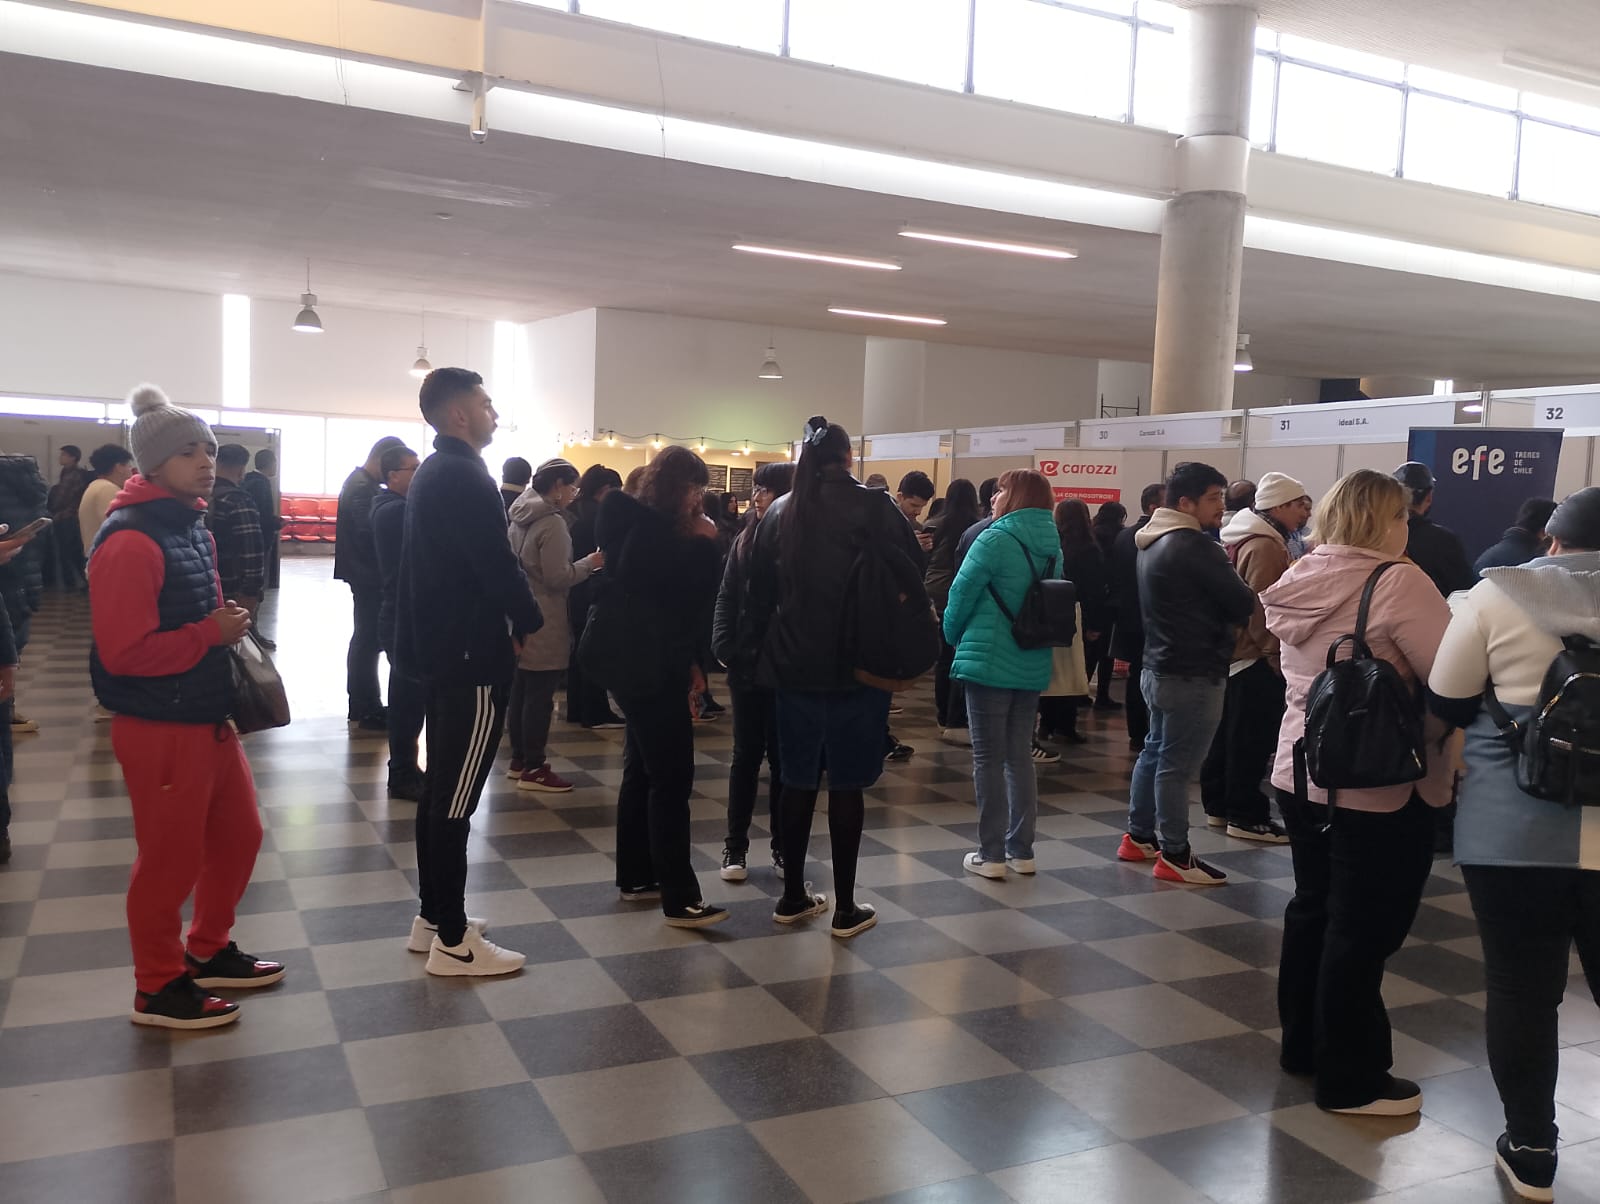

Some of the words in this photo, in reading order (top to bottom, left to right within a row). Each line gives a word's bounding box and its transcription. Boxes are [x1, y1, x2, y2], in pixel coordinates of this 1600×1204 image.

[1545, 407, 1564, 420] 32
[1280, 420, 1290, 431] 31
[1099, 430, 1109, 440] 30
[1062, 463, 1117, 475] carozzi
[1451, 445, 1505, 481] efe
